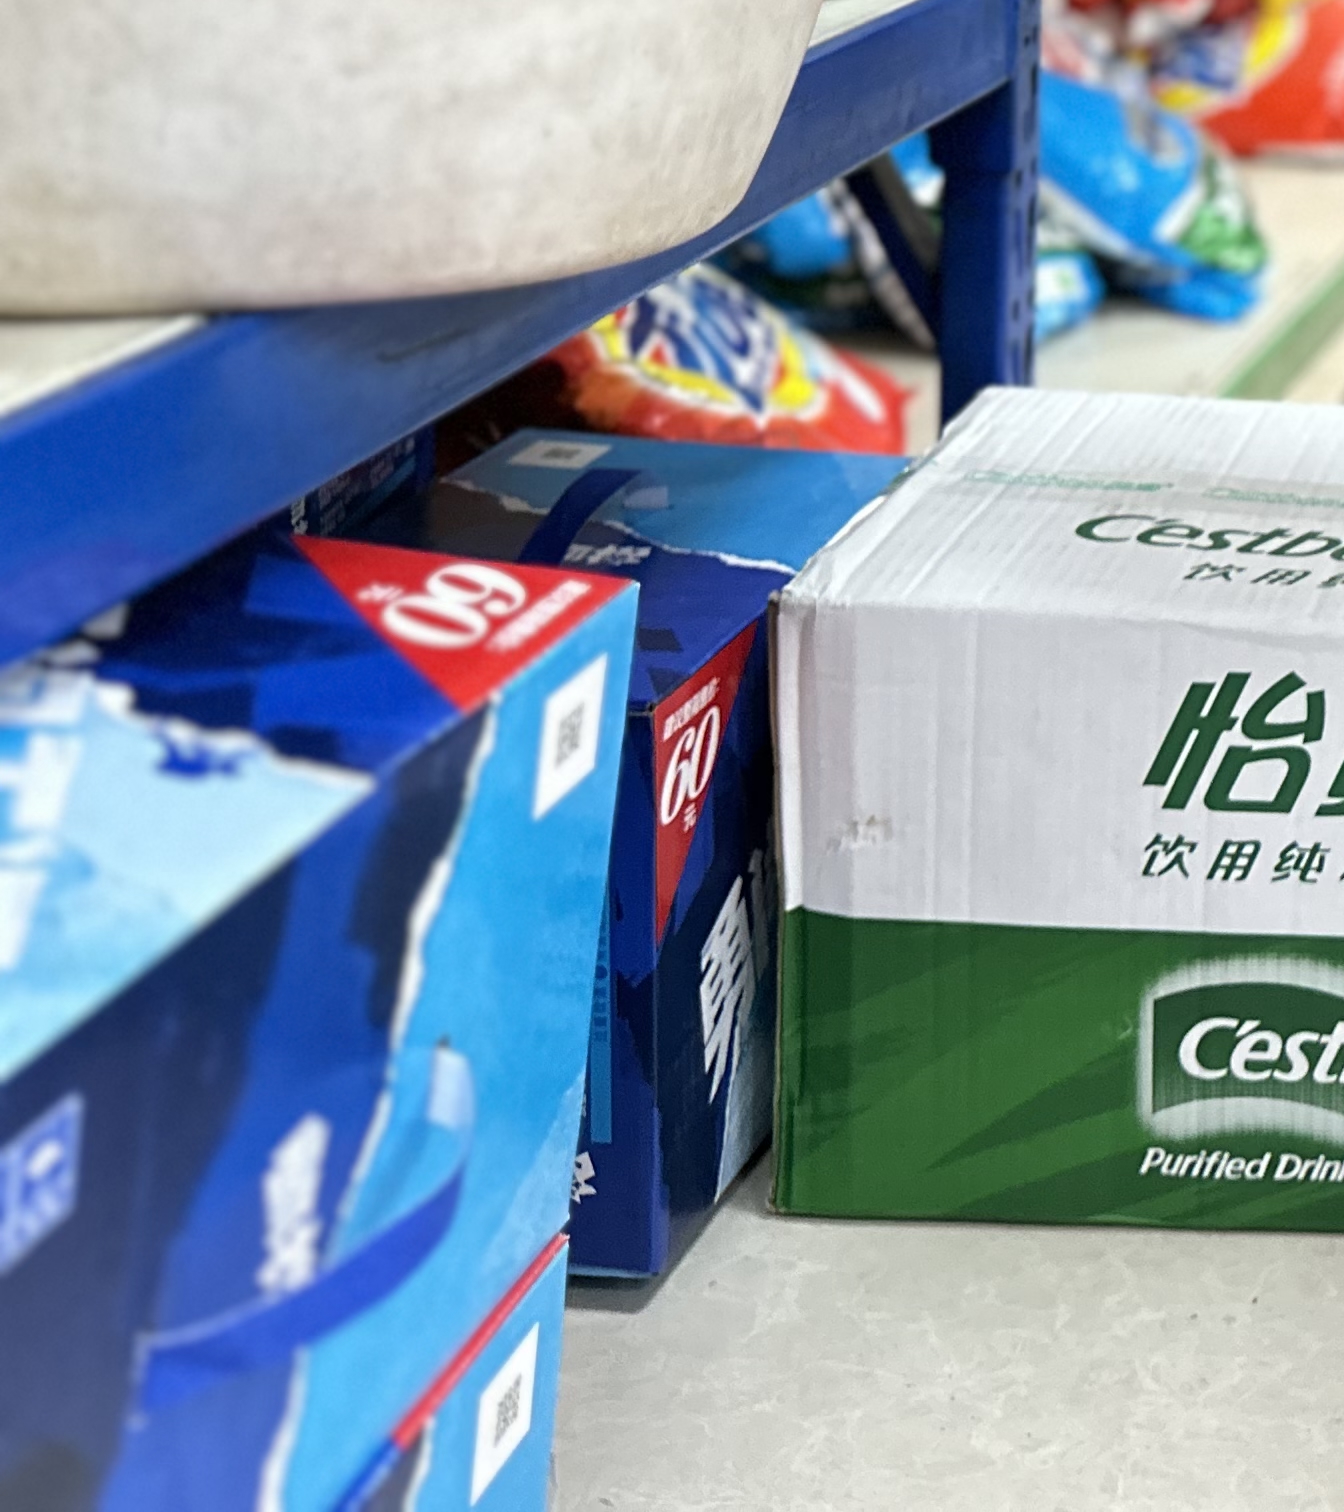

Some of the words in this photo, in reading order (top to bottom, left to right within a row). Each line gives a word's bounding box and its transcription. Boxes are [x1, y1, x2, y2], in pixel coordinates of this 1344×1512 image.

[380, 563, 528, 649] 60
[661, 705, 721, 826] 60
[1138, 1146, 1272, 1181] Purified
